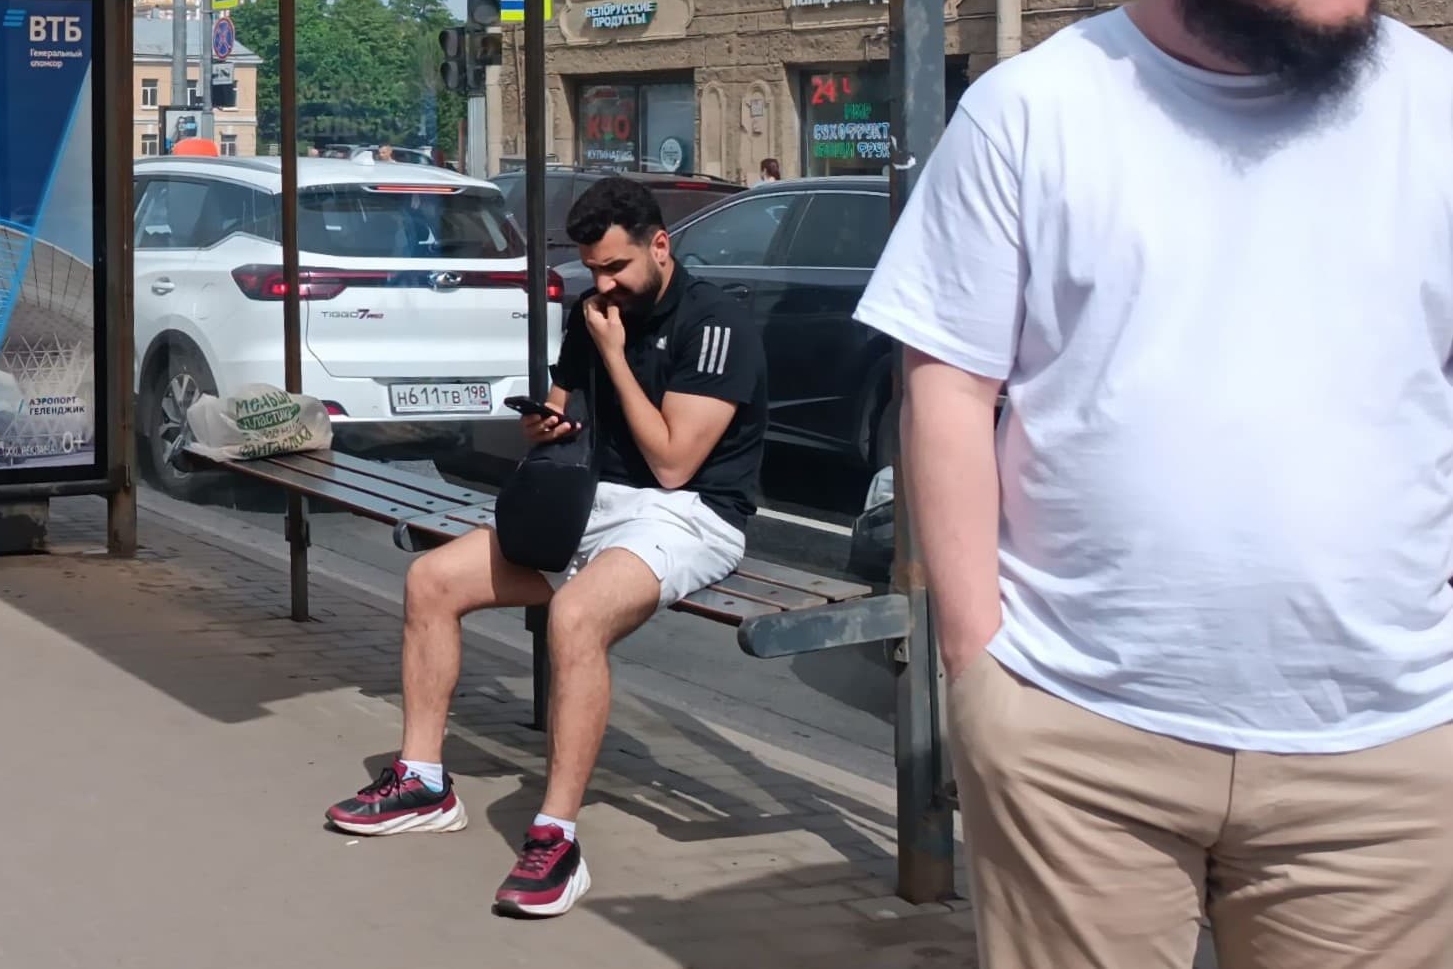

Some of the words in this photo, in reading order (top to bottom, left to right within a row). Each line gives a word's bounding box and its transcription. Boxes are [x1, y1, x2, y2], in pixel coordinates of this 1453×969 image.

[585, 0, 657, 17] БЕЛОРУССКИЕ
[592, 13, 646, 28] ПРОДУКТЫ
[29, 15, 82, 42] ВТБ
[30, 48, 83, 59] Генеральный
[30, 60, 63, 69] спонсор
[813, 122, 890, 141] СУХОФРУКТ
[464, 385, 487, 399] 198
[29, 396, 76, 406] АЭРОПОРТ
[29, 406, 85, 416] ГЕЛЕНДЖИК
[62, 431, 85, 453] 0+
